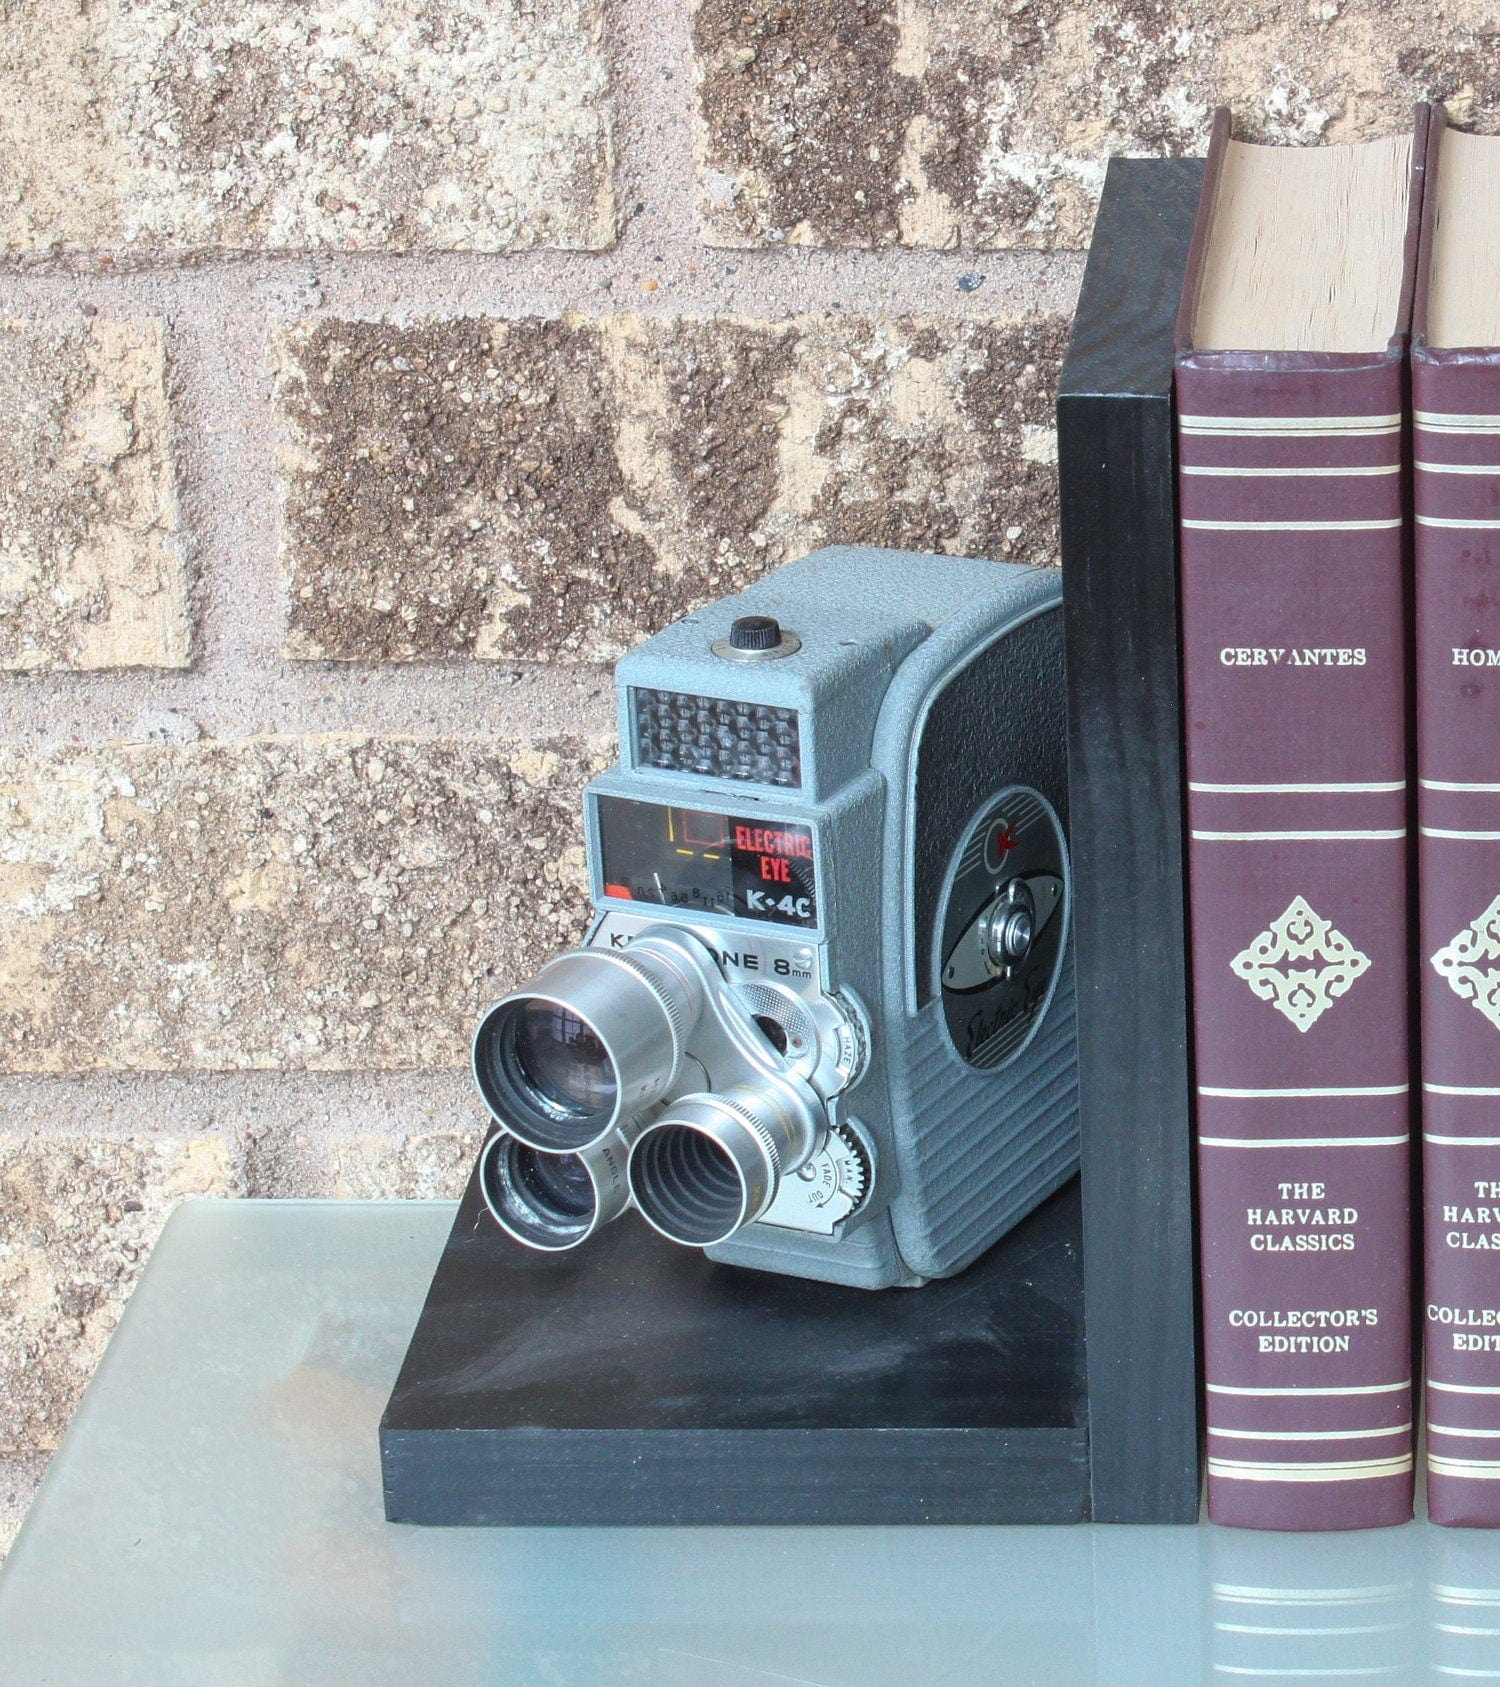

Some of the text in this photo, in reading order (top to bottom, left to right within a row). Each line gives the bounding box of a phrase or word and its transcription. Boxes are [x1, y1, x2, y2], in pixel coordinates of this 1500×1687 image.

[1219, 647, 1367, 666] CERVANTES
[736, 826, 812, 859] ELECTRIC
[761, 856, 791, 883] EYE
[843, 1036, 852, 1065] HAZE
[808, 1163, 832, 1203] FADE OUT
[1277, 1182, 1326, 1200] THE
[1246, 1207, 1359, 1226] HARVARD
[1250, 1233, 1355, 1252] CLASSICS
[1228, 1308, 1378, 1328] COLLECTOR'S
[1258, 1335, 1350, 1353] EDITION
